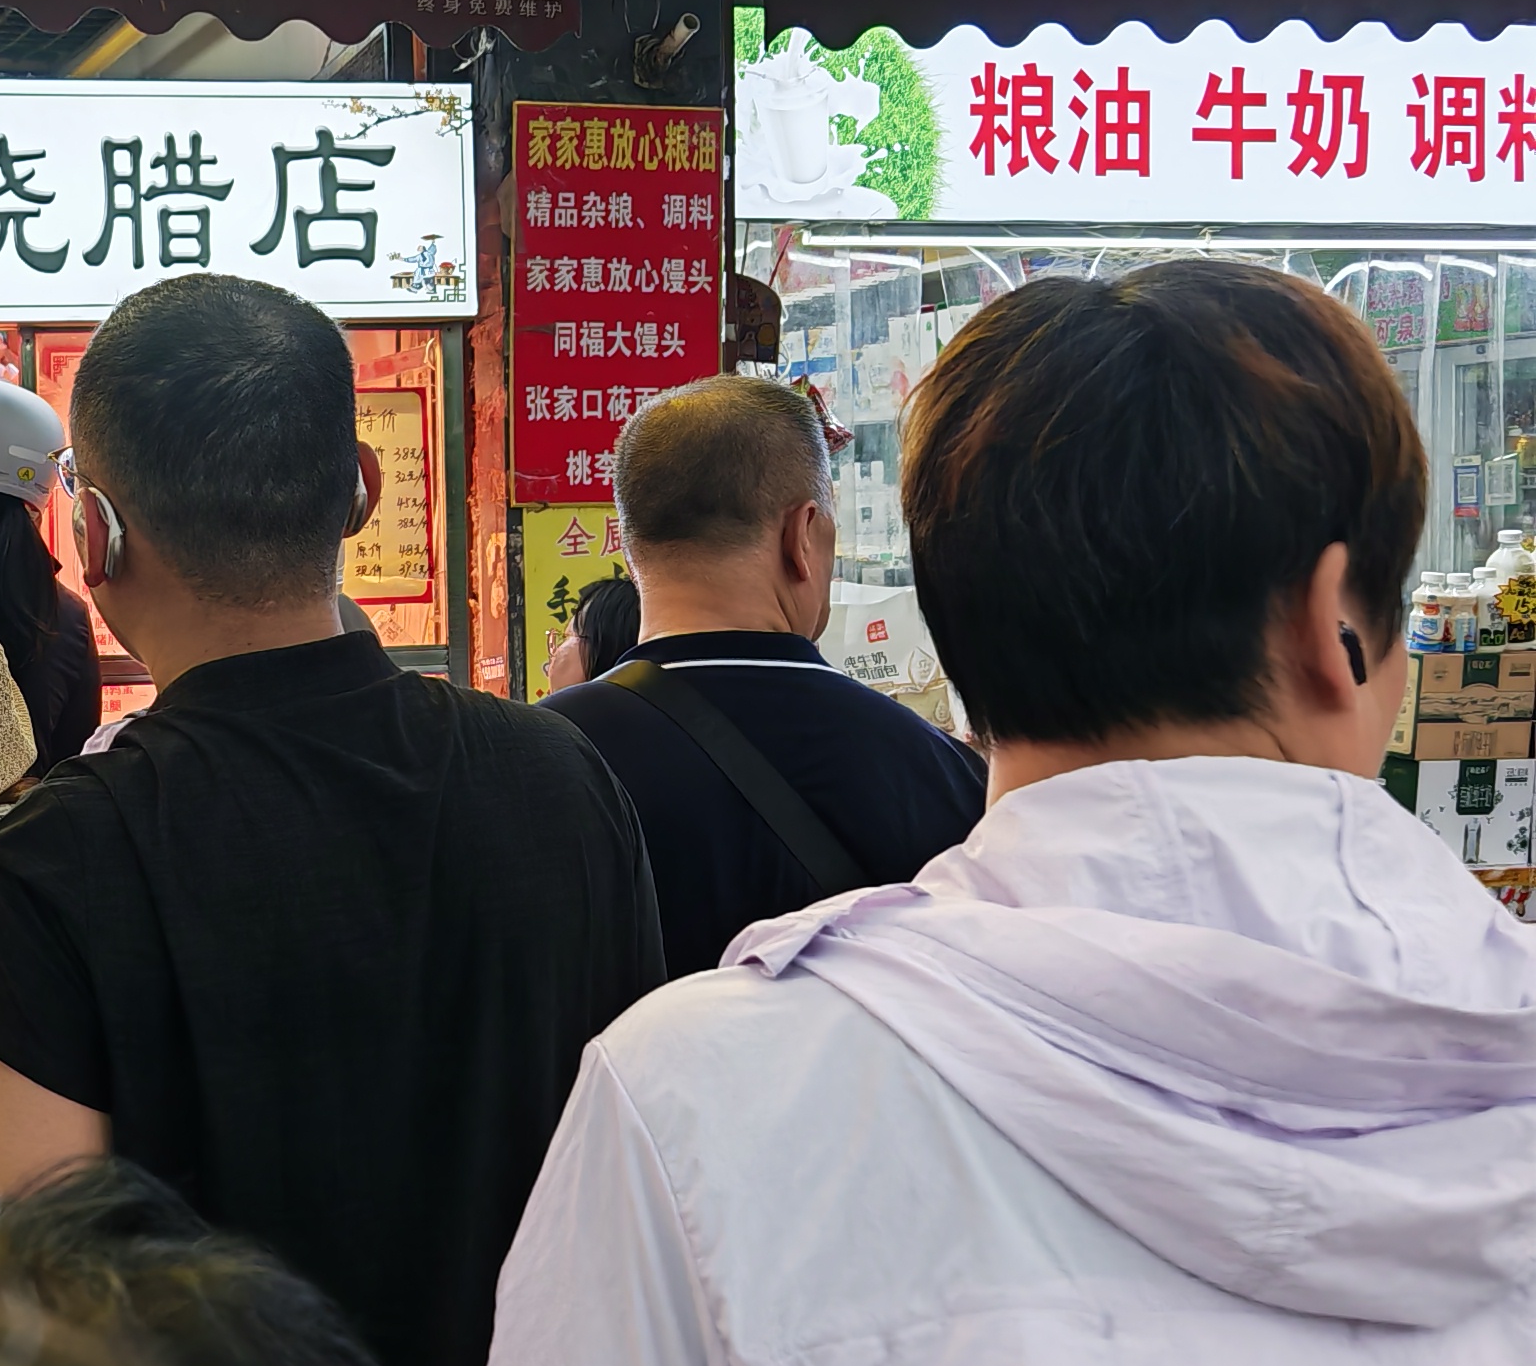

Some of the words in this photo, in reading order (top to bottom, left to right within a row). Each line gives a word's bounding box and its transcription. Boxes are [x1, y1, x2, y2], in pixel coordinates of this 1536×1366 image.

[968, 61, 1152, 180] 粮油
[1191, 66, 1370, 182] 牛奶
[527, 115, 717, 173] 家家惠放心粮油
[526, 189, 714, 231] 精品杂粮、调料
[526, 255, 713, 294] 家家惠放心馒头
[553, 321, 686, 358] 同福大馒头
